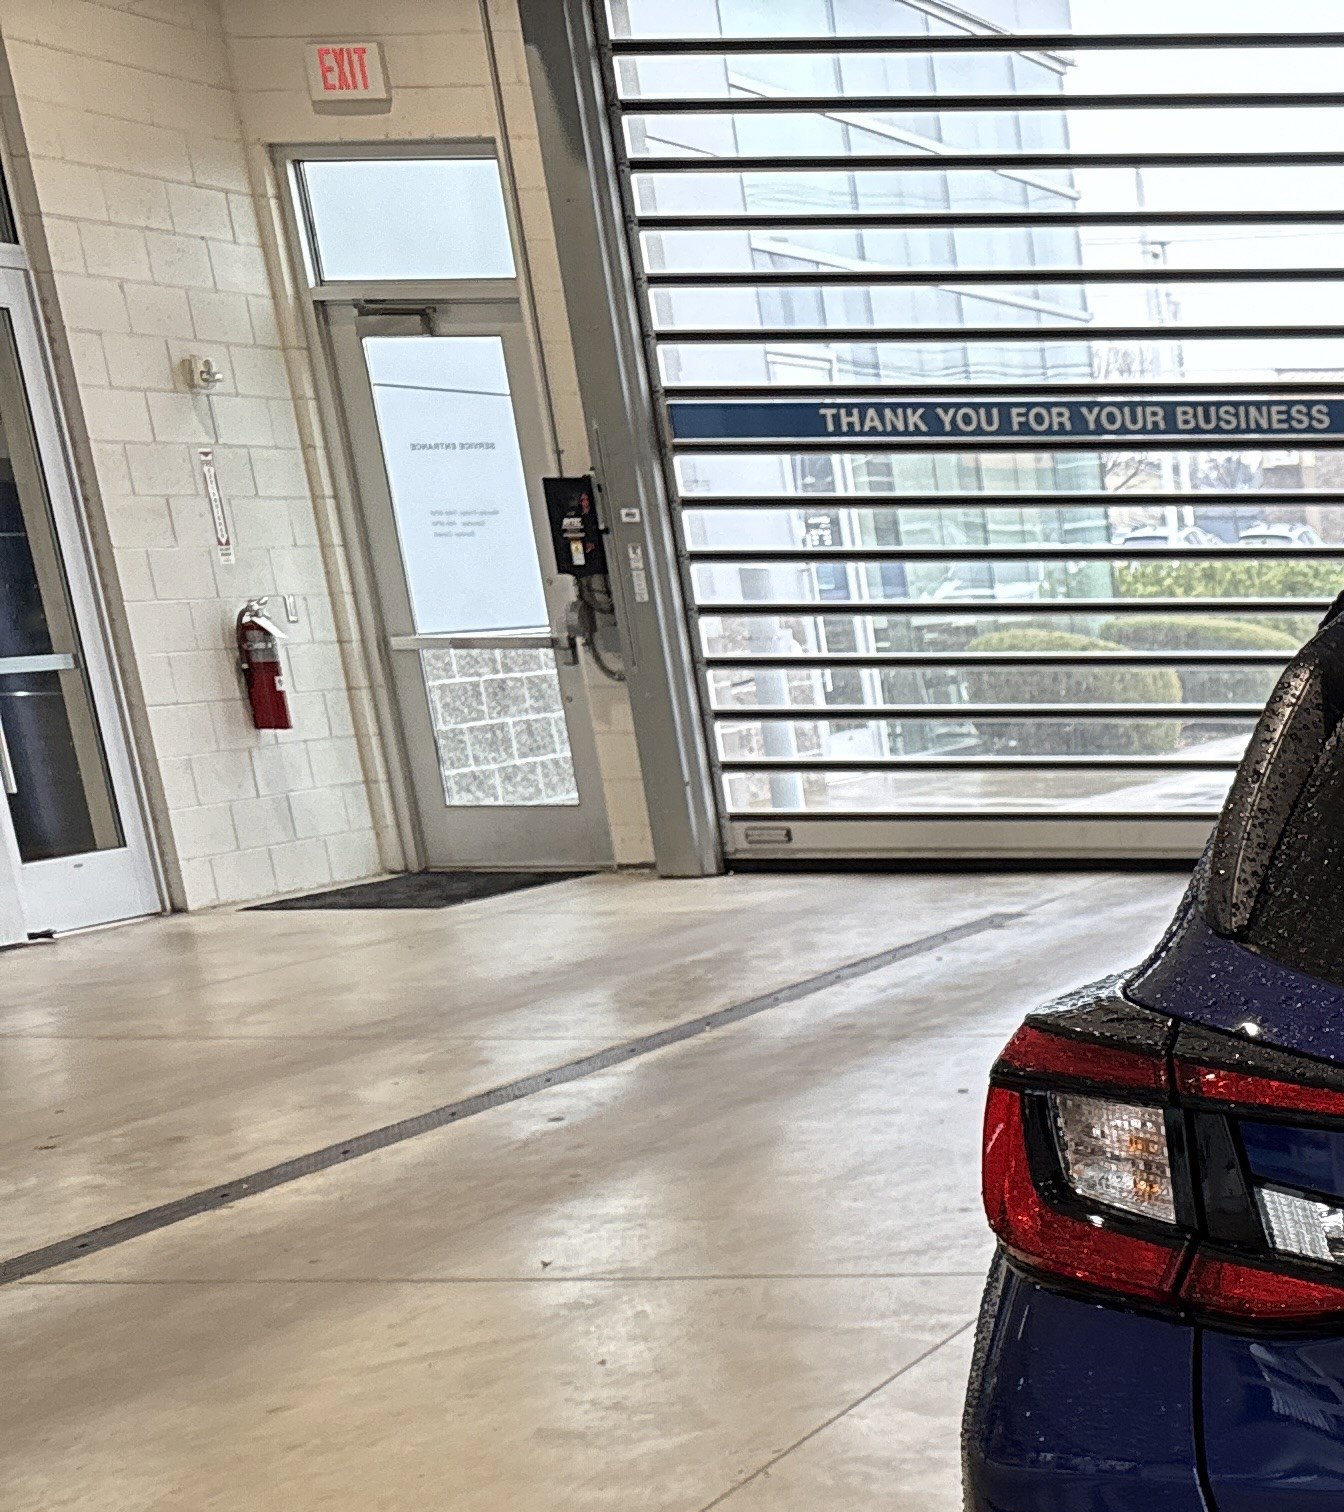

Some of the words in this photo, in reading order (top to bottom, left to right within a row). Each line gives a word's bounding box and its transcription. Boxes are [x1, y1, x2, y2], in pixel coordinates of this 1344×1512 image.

[317, 47, 369, 91] EXIT
[818, 407, 928, 432] THANK
[936, 407, 999, 432] YOU
[1010, 406, 1072, 431] FOR
[1080, 405, 1166, 431] YOUR
[1175, 404, 1330, 430] BUSINESS
